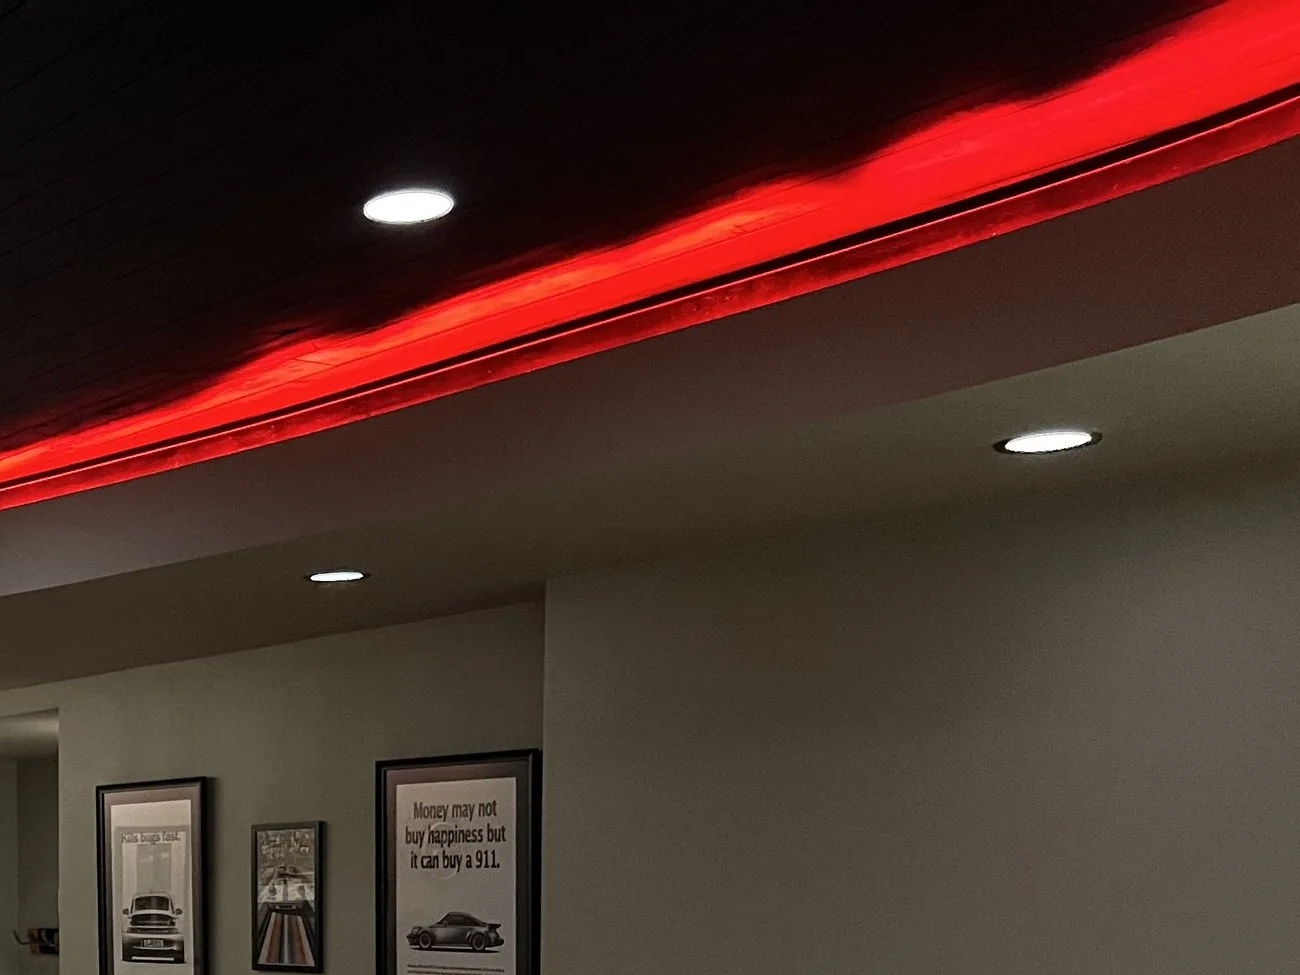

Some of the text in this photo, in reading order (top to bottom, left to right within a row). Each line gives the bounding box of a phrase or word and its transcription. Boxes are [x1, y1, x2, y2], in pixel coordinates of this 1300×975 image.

[413, 800, 497, 822] Money may not
[405, 823, 506, 848] buy happiness but
[410, 850, 500, 873] it can buy a 911.
